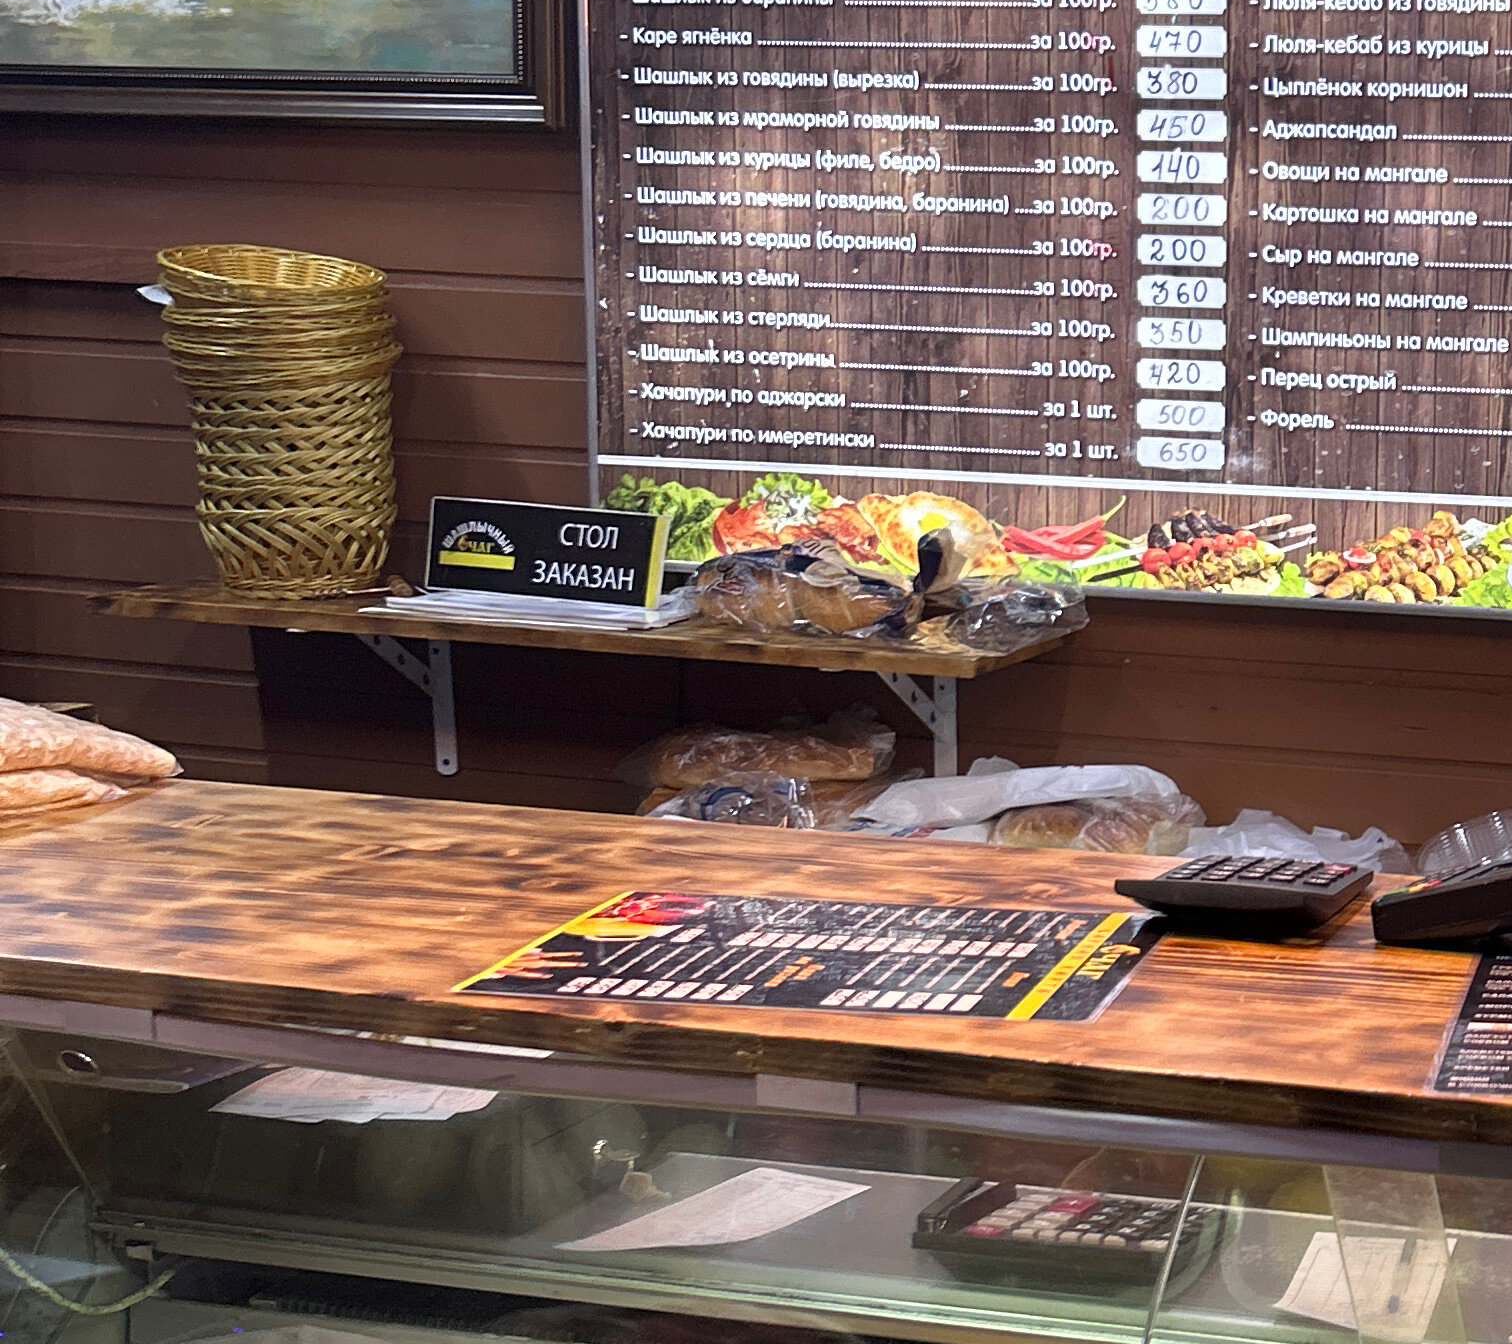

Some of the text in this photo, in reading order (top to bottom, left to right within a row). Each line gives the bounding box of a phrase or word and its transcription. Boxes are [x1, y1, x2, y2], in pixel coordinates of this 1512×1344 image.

[633, 27, 1115, 54] Каре ягнёнка за 100гр.
[1149, 30, 1202, 53] 470
[1263, 35, 1488, 59] Люля-кебаб из курицы
[634, 68, 1117, 96] Шашлык из говядины (вырезка) за 100гр.
[1147, 71, 1198, 94] 380
[1264, 77, 1467, 101] Цыплёнок корнишон
[635, 107, 1118, 137] Шашлык из мраморной говядины за 100гр.
[1150, 113, 1205, 138] 450
[1262, 120, 1396, 141] Аджапсандал
[637, 147, 1119, 179] Шашлык из курицы (филе, бедро) за 100гр.
[1152, 154, 1200, 182] 140
[1262, 161, 1448, 182] Овощи на мангале
[637, 187, 1117, 219] Шашлык из печени (говядина, баранина) за 100гр.
[1152, 196, 1210, 221] 200
[1262, 202, 1477, 225] Картошка на мангале
[638, 227, 1116, 260] Шашлык из сердца (баранина) за 100гр.
[1150, 239, 1205, 262] 200
[1262, 245, 1419, 267] Сыр на мангале
[639, 266, 799, 286] Шашлык из сёмги
[1151, 280, 1207, 304] 360
[1262, 286, 1467, 309] Креветки на мангале
[640, 305, 829, 329] Шашлык из стерляди
[1150, 321, 1201, 344] 350
[1262, 328, 1509, 352] Шампиньоны на мангале
[641, 344, 1115, 382] Шашлык из осетрины за 100гр.
[1261, 368, 1322, 390] Перец
[1326, 373, 1396, 393] острый
[641, 383, 1116, 419] Хачапури по аджарски за 1 шт.
[1157, 405, 1205, 426] 500
[1260, 409, 1334, 431] Форель
[642, 422, 1118, 459] Хачапури по имеретински за 1 шт.
[1160, 443, 1206, 462] 650
[442, 521, 515, 554] ШАШЛЫЧНЫЙ
[560, 523, 619, 550] СТОЛ
[532, 560, 635, 592] ЗАКАЗАН
